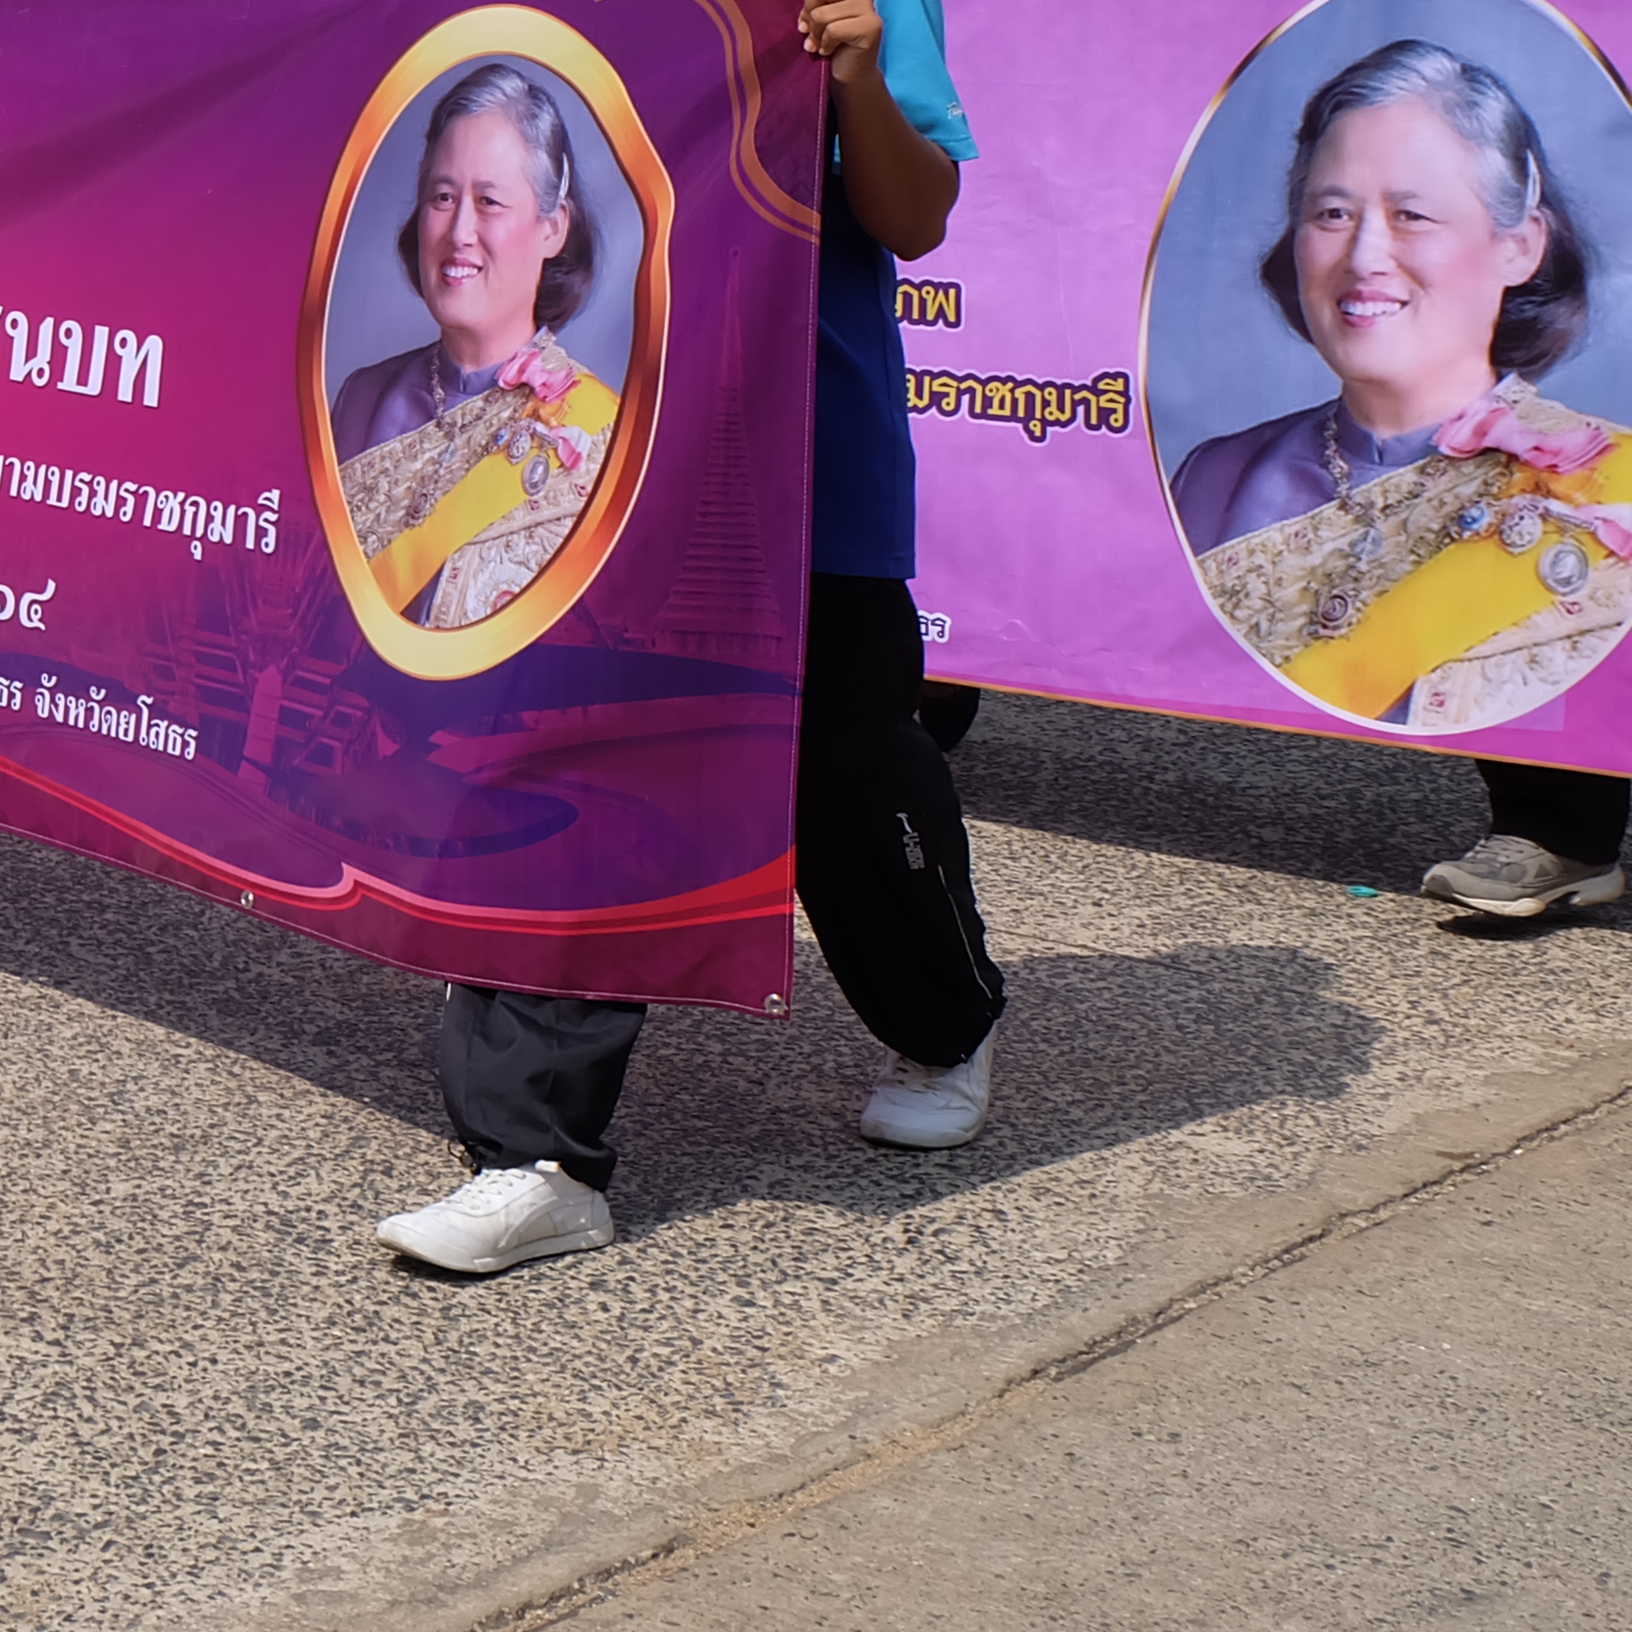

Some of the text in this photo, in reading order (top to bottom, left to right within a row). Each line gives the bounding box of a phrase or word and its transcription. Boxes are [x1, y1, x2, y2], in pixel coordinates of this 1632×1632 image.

[35, 673, 198, 761] จังหวัดยโสธร
